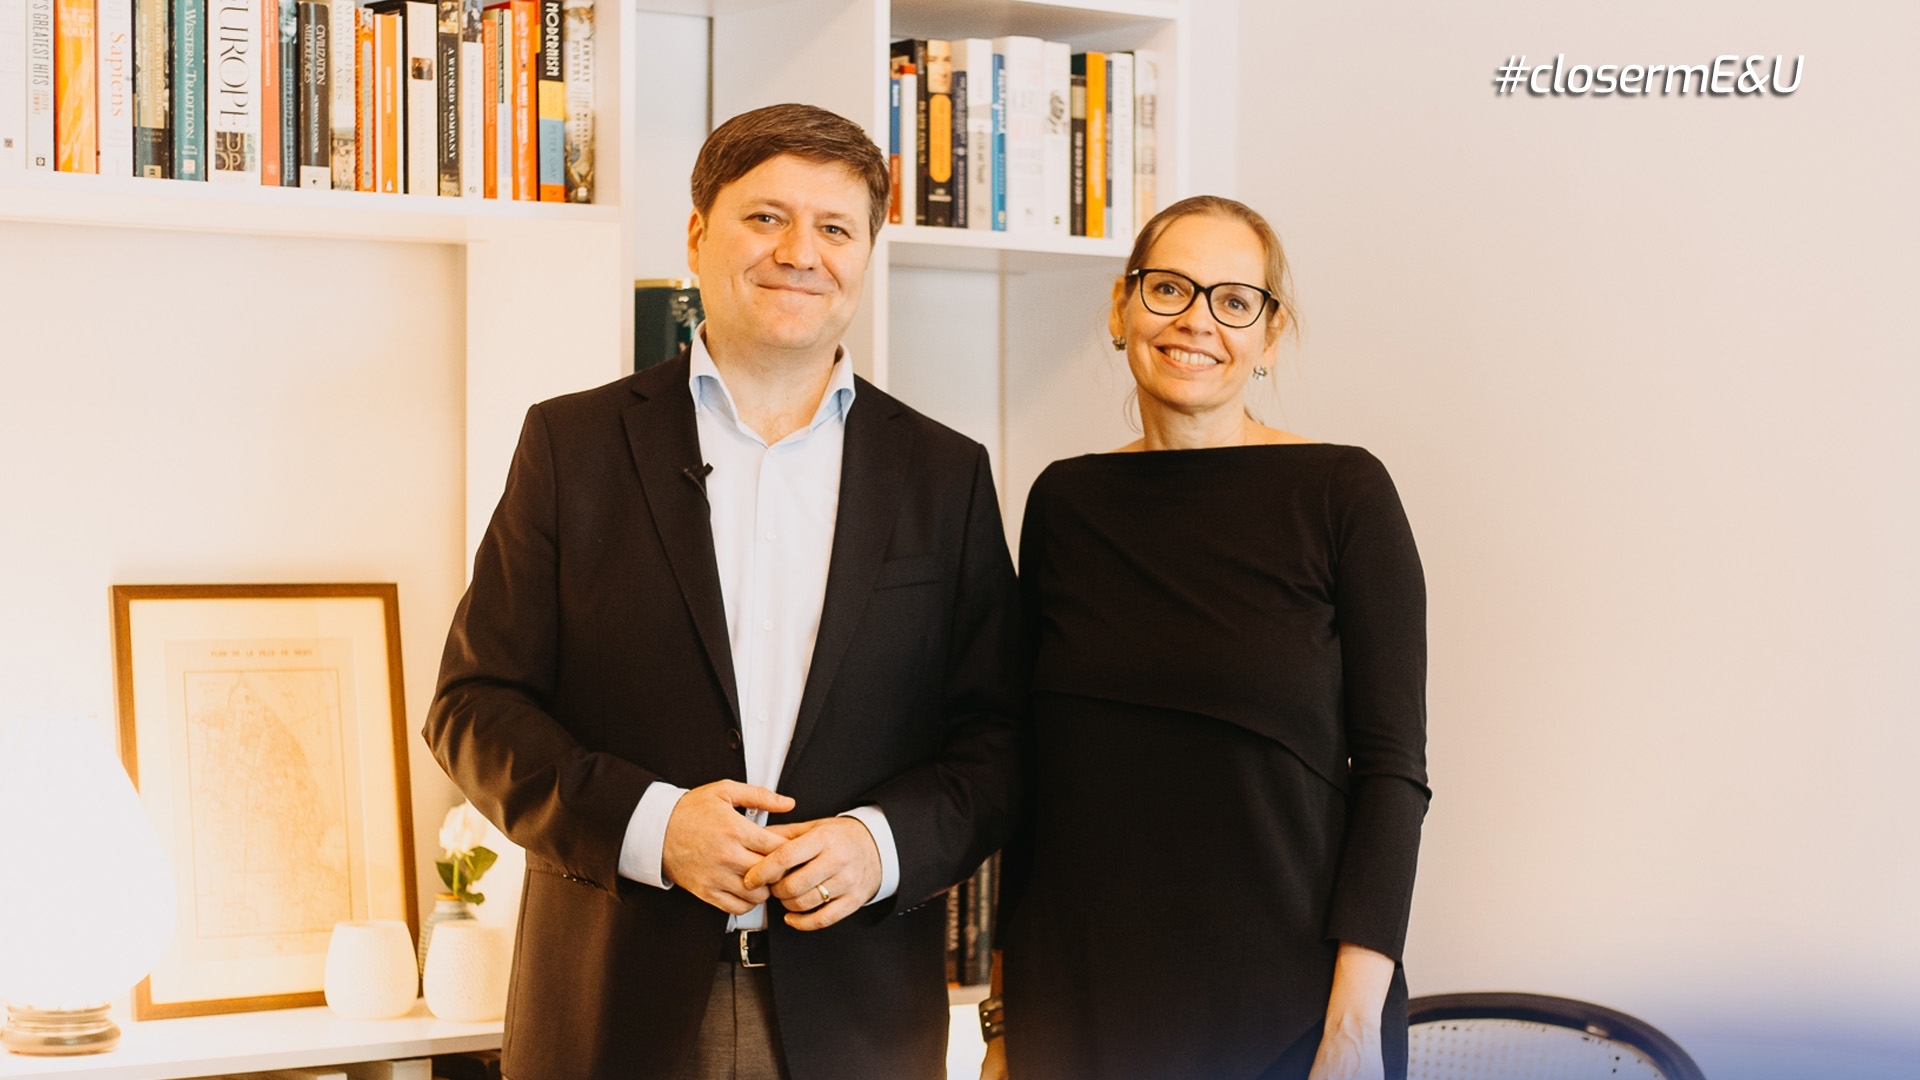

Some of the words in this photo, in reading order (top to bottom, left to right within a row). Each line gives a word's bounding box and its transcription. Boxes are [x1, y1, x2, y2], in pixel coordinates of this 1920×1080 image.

[32, 12, 49, 62] GREATEST
[184, 8, 197, 67] WESTERN
[303, 23, 312, 60] MIDDLE
[315, 24, 326, 86] CIVILIZATION
[335, 3, 343, 58] MIDDLE
[345, 4, 353, 85] MYSTERIES
[448, 47, 455, 56] A
[545, 2, 559, 77] MODERNISM
[32, 63, 49, 87] HITS
[104, 31, 128, 117] Sapiens
[155, 56, 162, 68] TO
[303, 61, 313, 84] AGES
[335, 65, 343, 101] AGES
[448, 57, 456, 103] WICKED
[184, 70, 197, 140] TRADITION
[448, 104, 457, 160] COMPANY
